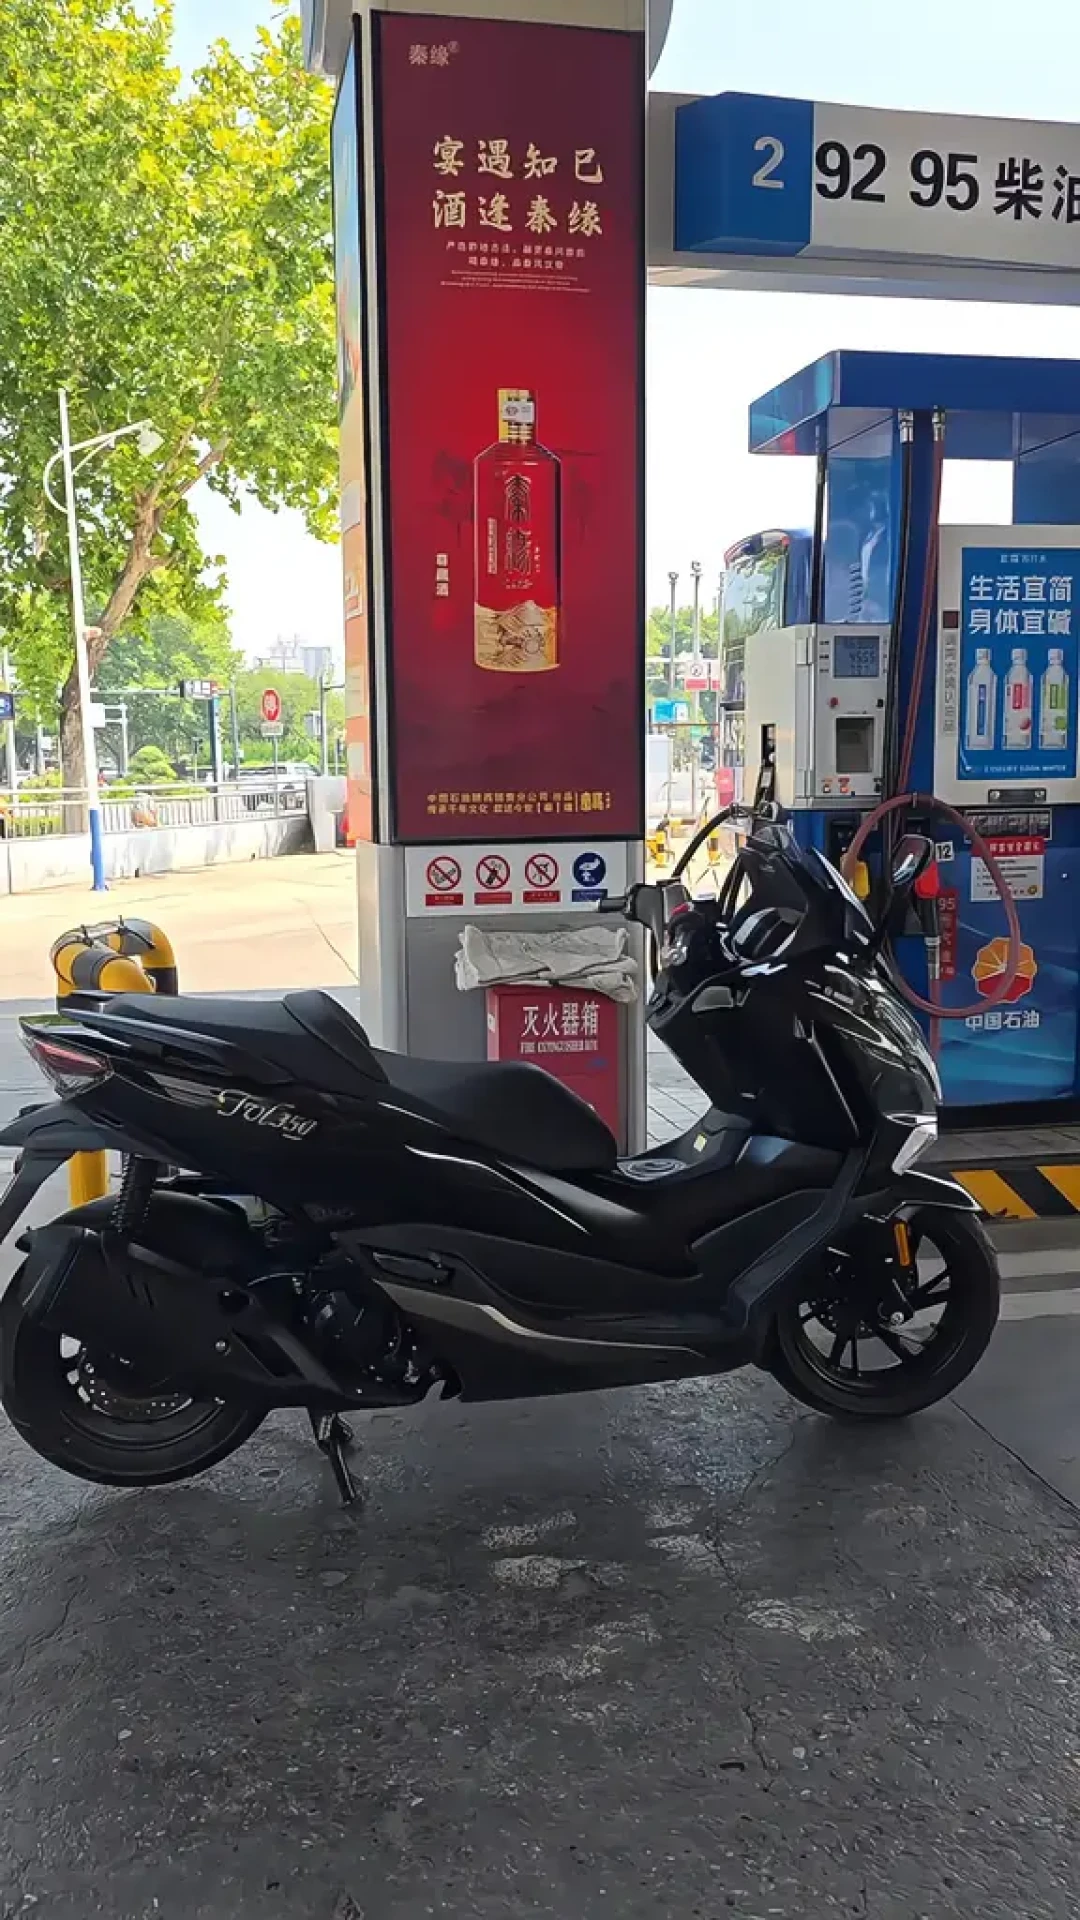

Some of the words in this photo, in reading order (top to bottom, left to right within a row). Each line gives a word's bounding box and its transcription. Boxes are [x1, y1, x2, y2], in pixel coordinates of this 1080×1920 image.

[752, 136, 786, 190] 2
[815, 140, 887, 203] 92
[910, 149, 980, 212] 95
[968, 575, 1073, 602] 生活宜简
[968, 608, 1072, 635] 身体宜碱
[937, 844, 952, 860] 12
[938, 897, 955, 911] 95
[521, 1000, 600, 1037] 灭火器箱
[965, 1010, 1040, 1032] 中国石油
